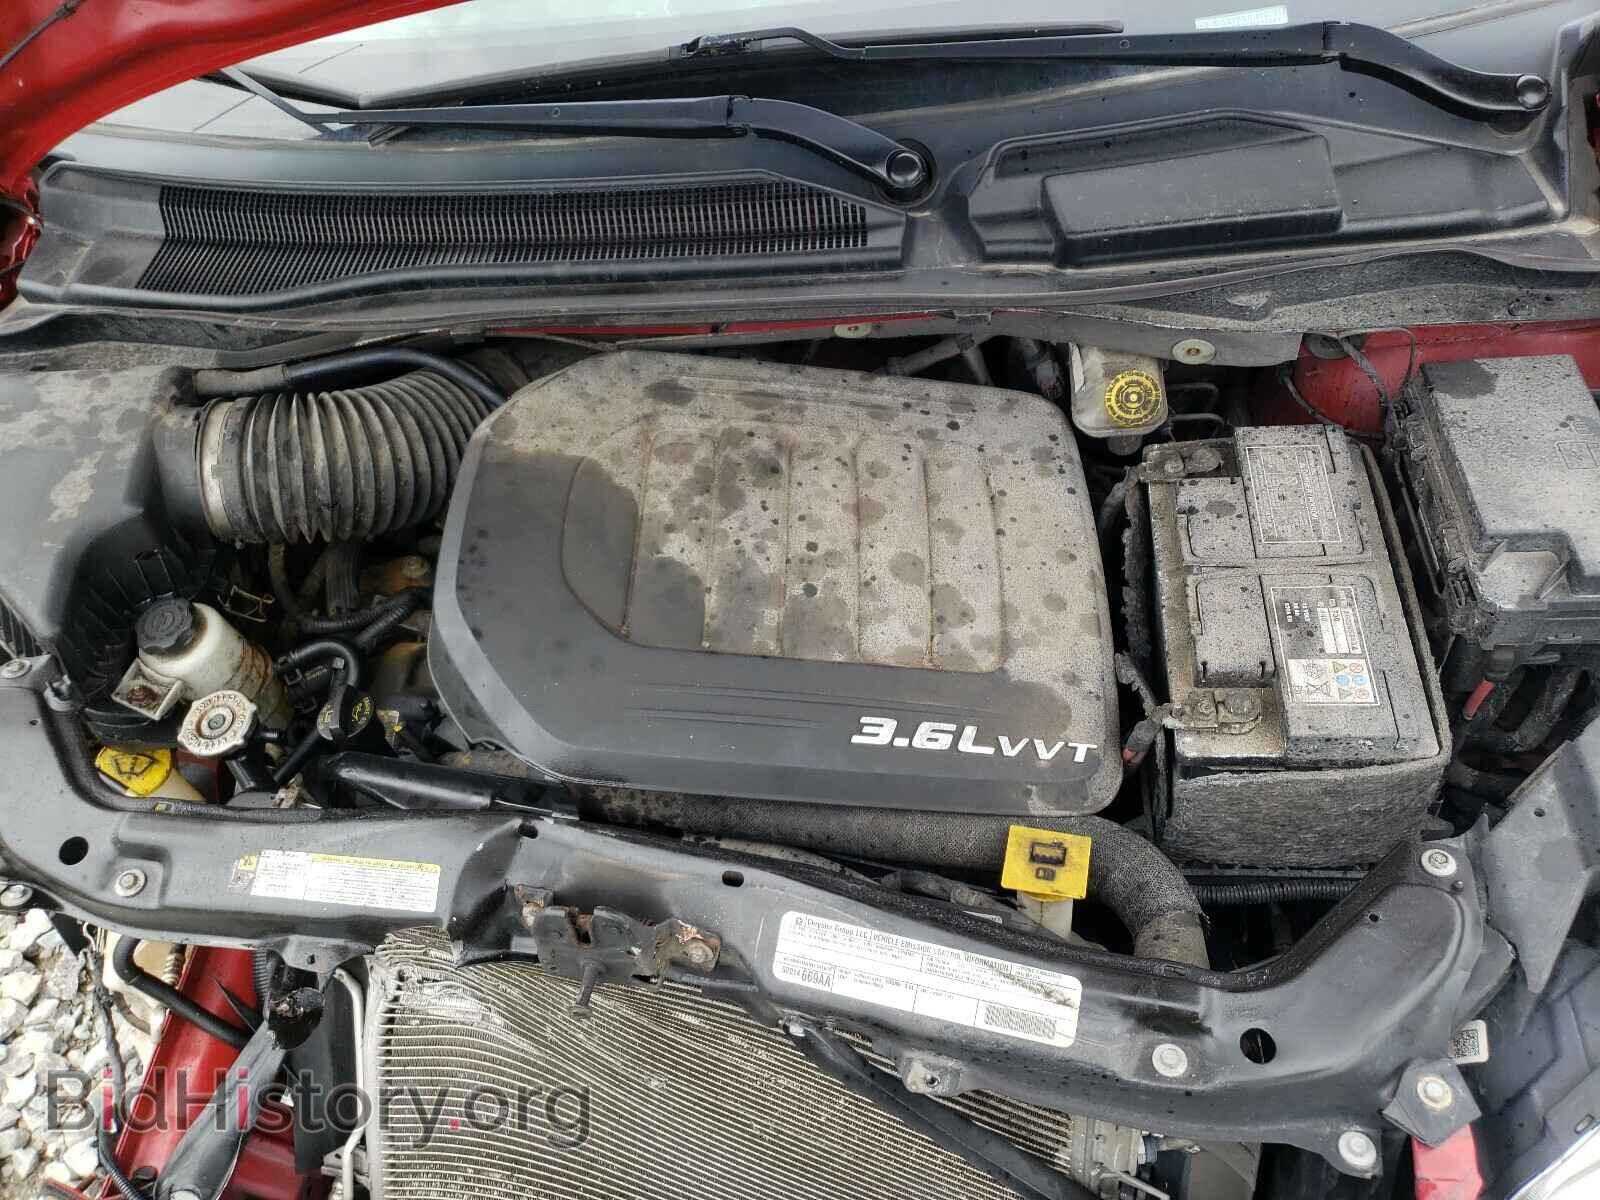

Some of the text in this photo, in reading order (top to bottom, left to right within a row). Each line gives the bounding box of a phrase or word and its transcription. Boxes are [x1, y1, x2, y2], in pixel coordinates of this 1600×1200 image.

[850, 716, 1098, 763] 3.6L VVT
[964, 952, 1009, 972] INFORMATION
